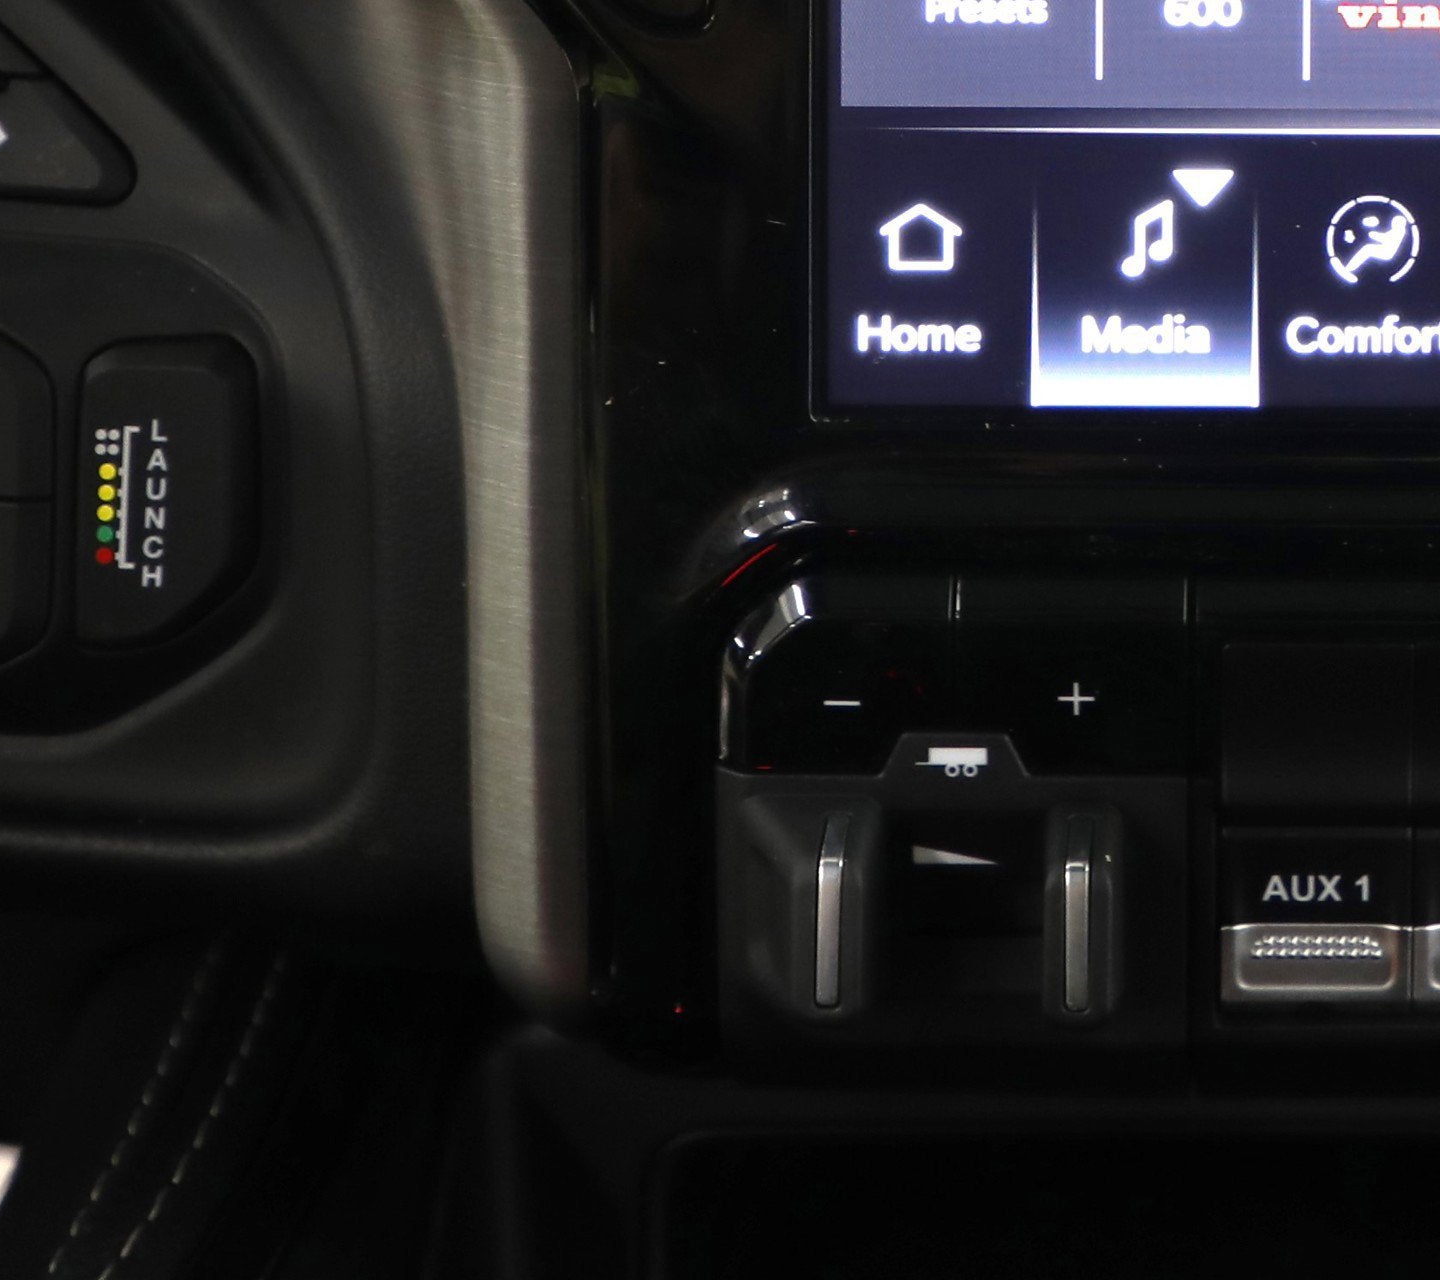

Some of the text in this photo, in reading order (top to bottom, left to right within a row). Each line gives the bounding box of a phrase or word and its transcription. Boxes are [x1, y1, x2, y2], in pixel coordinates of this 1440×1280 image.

[857, 315, 981, 353] Home
[1080, 315, 1210, 354] Media
[1263, 874, 1372, 903] AUX 1
